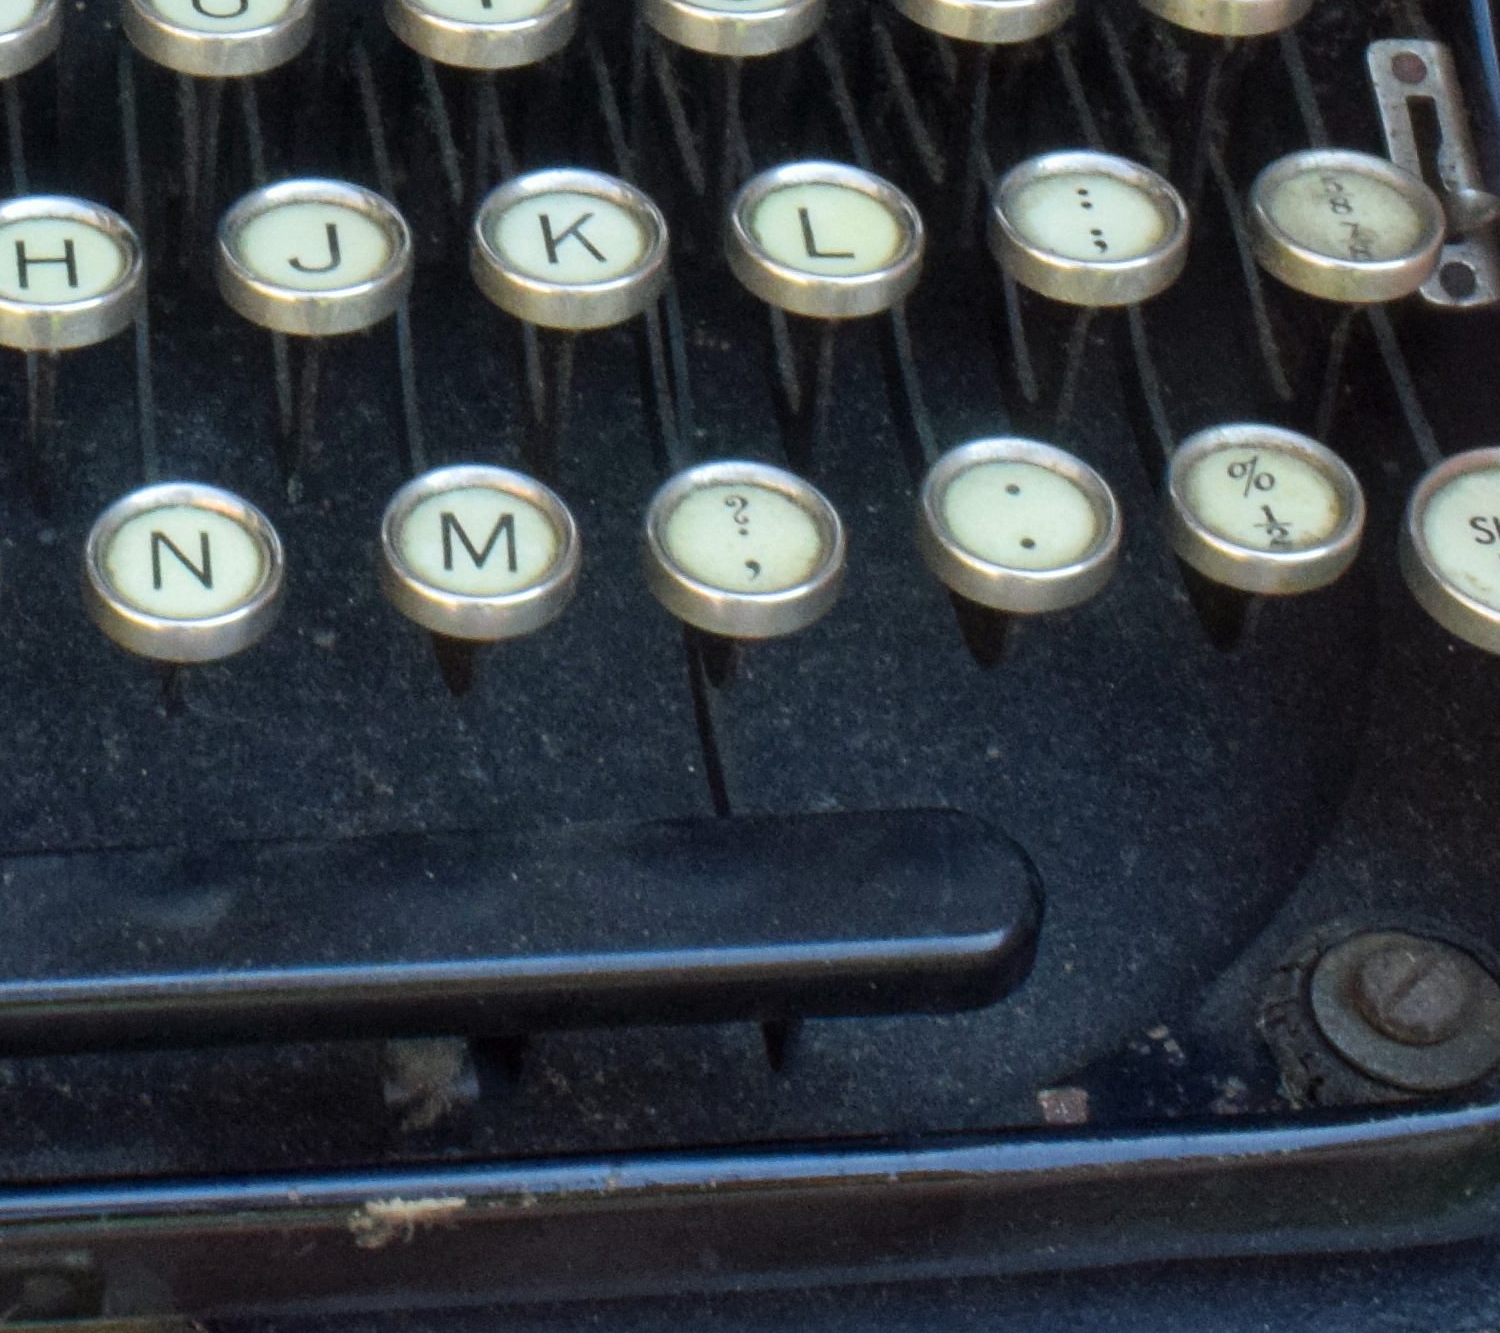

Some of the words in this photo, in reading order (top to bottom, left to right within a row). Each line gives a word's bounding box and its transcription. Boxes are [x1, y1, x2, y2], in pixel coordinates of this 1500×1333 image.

[288, 223, 341, 274] J
[539, 212, 608, 265] K
[797, 207, 856, 259] L
[15, 239, 79, 290] H
[150, 531, 213, 591] N
[440, 511, 518, 573] M
